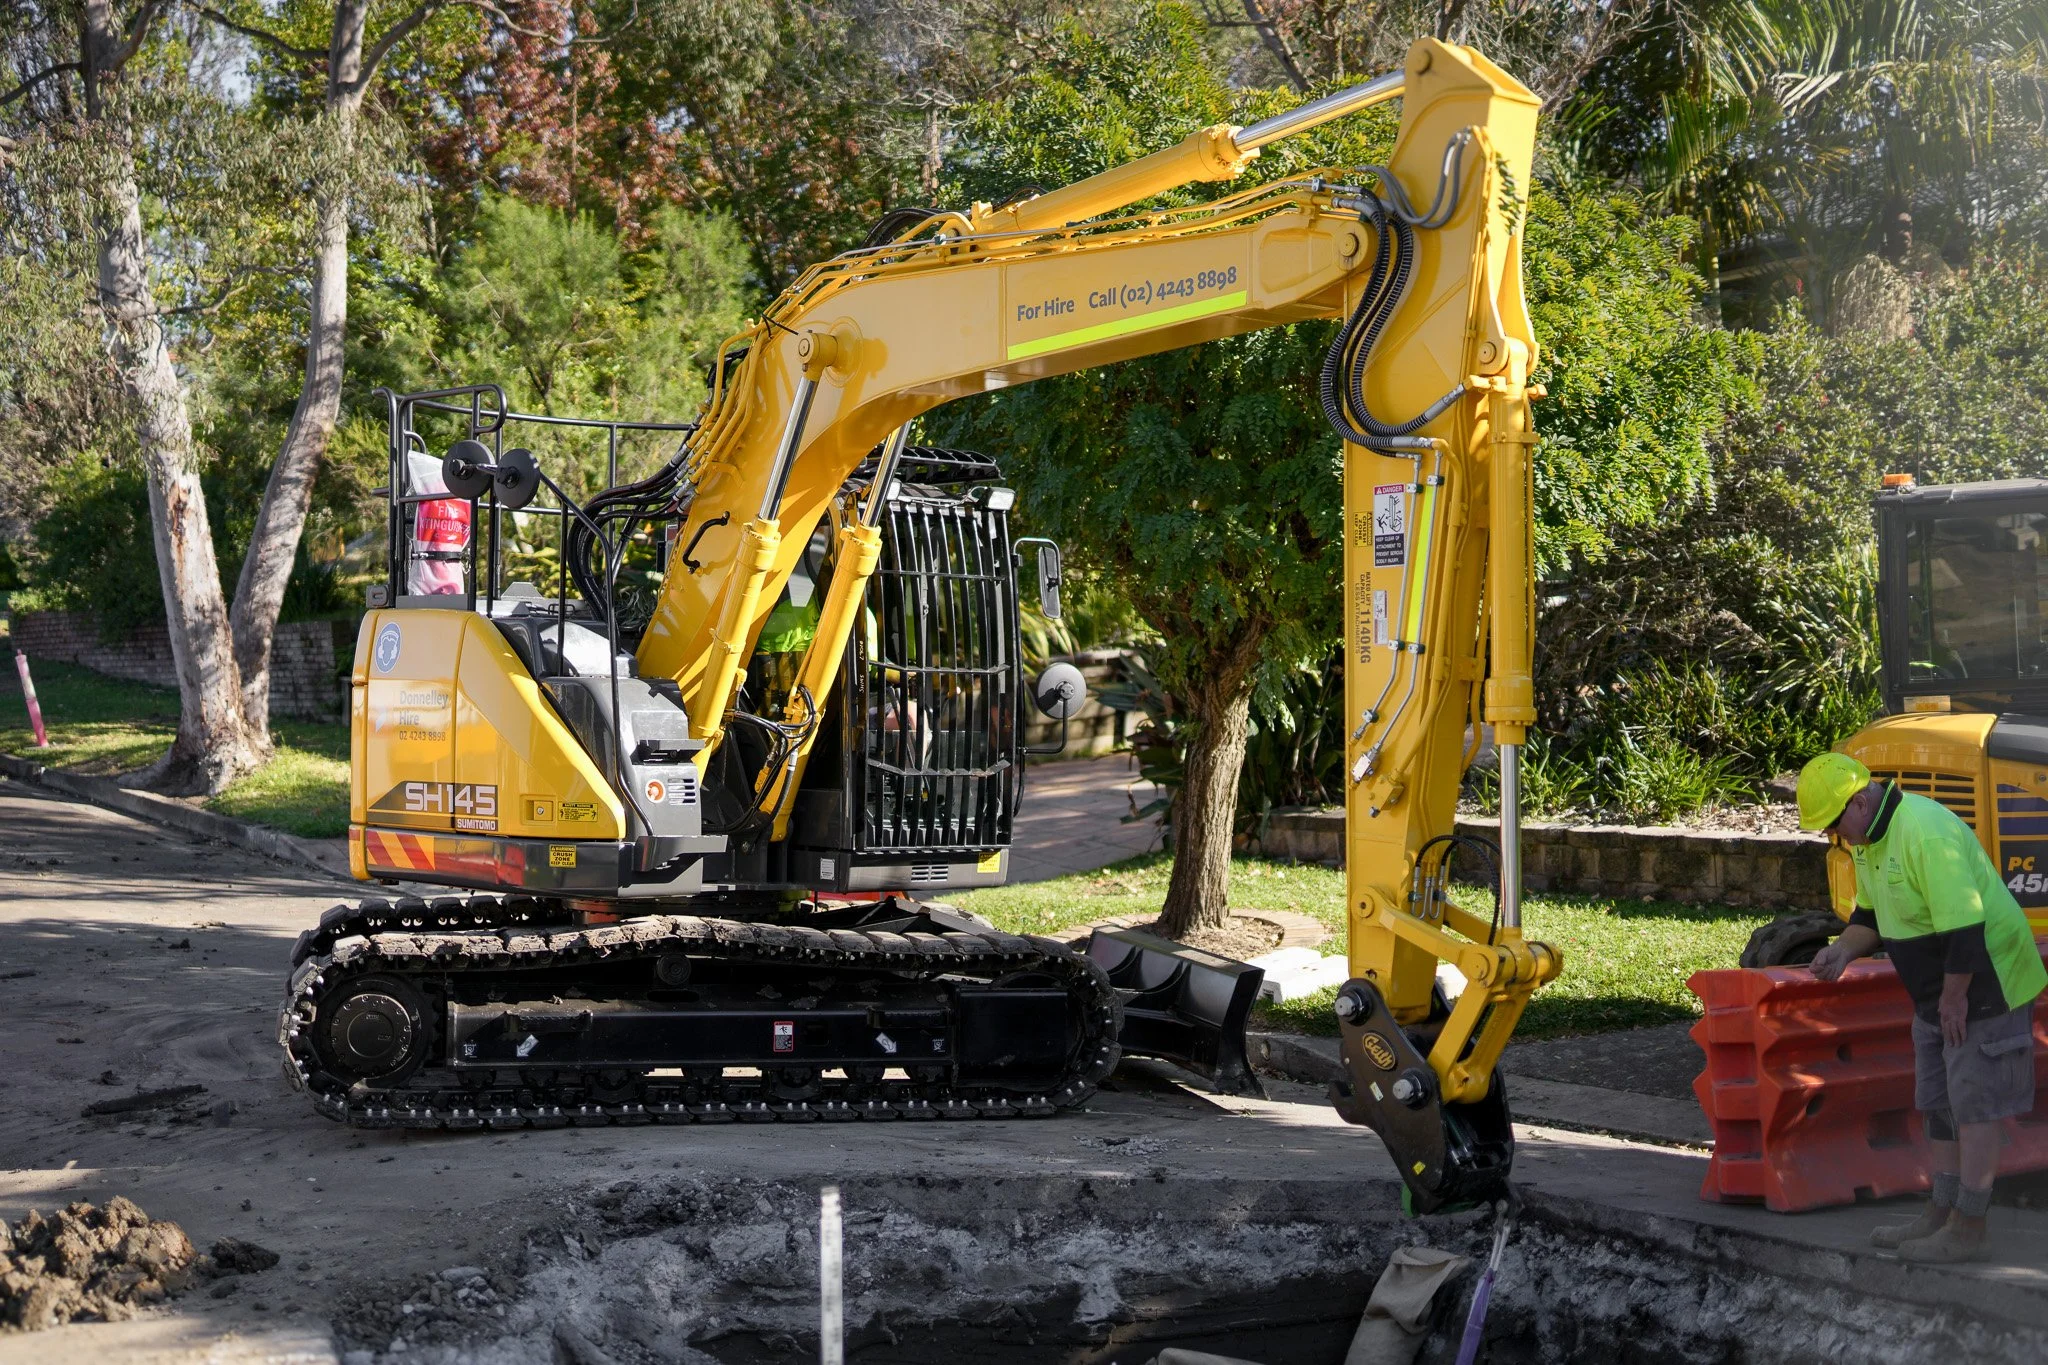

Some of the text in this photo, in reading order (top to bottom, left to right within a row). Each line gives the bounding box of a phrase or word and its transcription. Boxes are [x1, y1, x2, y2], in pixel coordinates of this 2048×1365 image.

[1089, 266, 1237, 309] Call (02) 4243 8898
[1017, 297, 1075, 321] For Hire
[1382, 485, 1402, 494] DANGER
[399, 690, 449, 709] Donnelley
[399, 710, 420, 725] Hire
[399, 730, 446, 742] 02 4243 8898
[405, 782, 496, 815] SH145
[457, 818, 496, 831] SUMITOMO
[2008, 856, 2035, 871] PC
